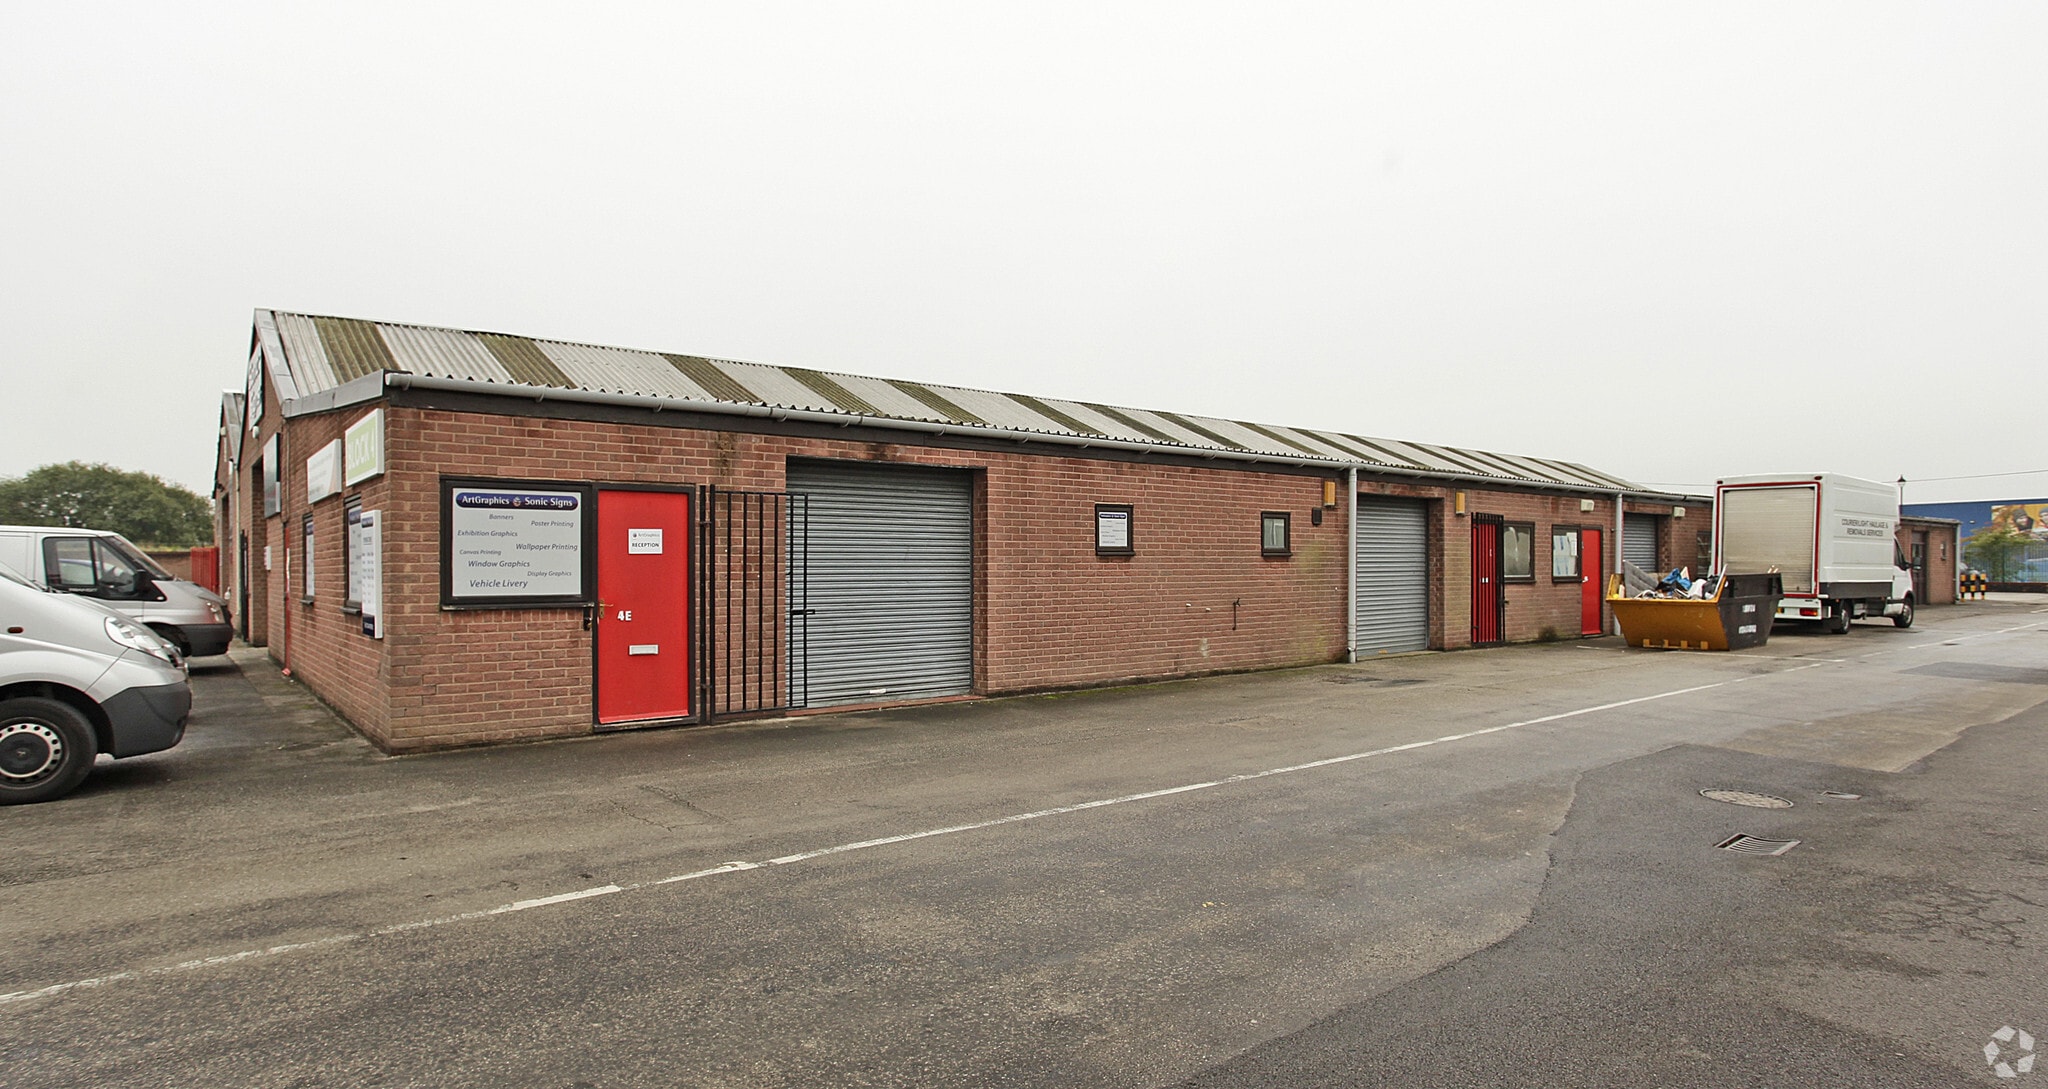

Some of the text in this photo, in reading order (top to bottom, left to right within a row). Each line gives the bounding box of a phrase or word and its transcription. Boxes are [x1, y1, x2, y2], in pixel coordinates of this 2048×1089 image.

[462, 495, 573, 508] ArtGraphics Sonic Signs
[490, 530, 518, 538] Graphics
[515, 543, 578, 552] Wallpaper Printing
[468, 560, 530, 569] Window Graphics
[469, 579, 529, 589] Vehicle Livery
[617, 611, 632, 620] 4E
